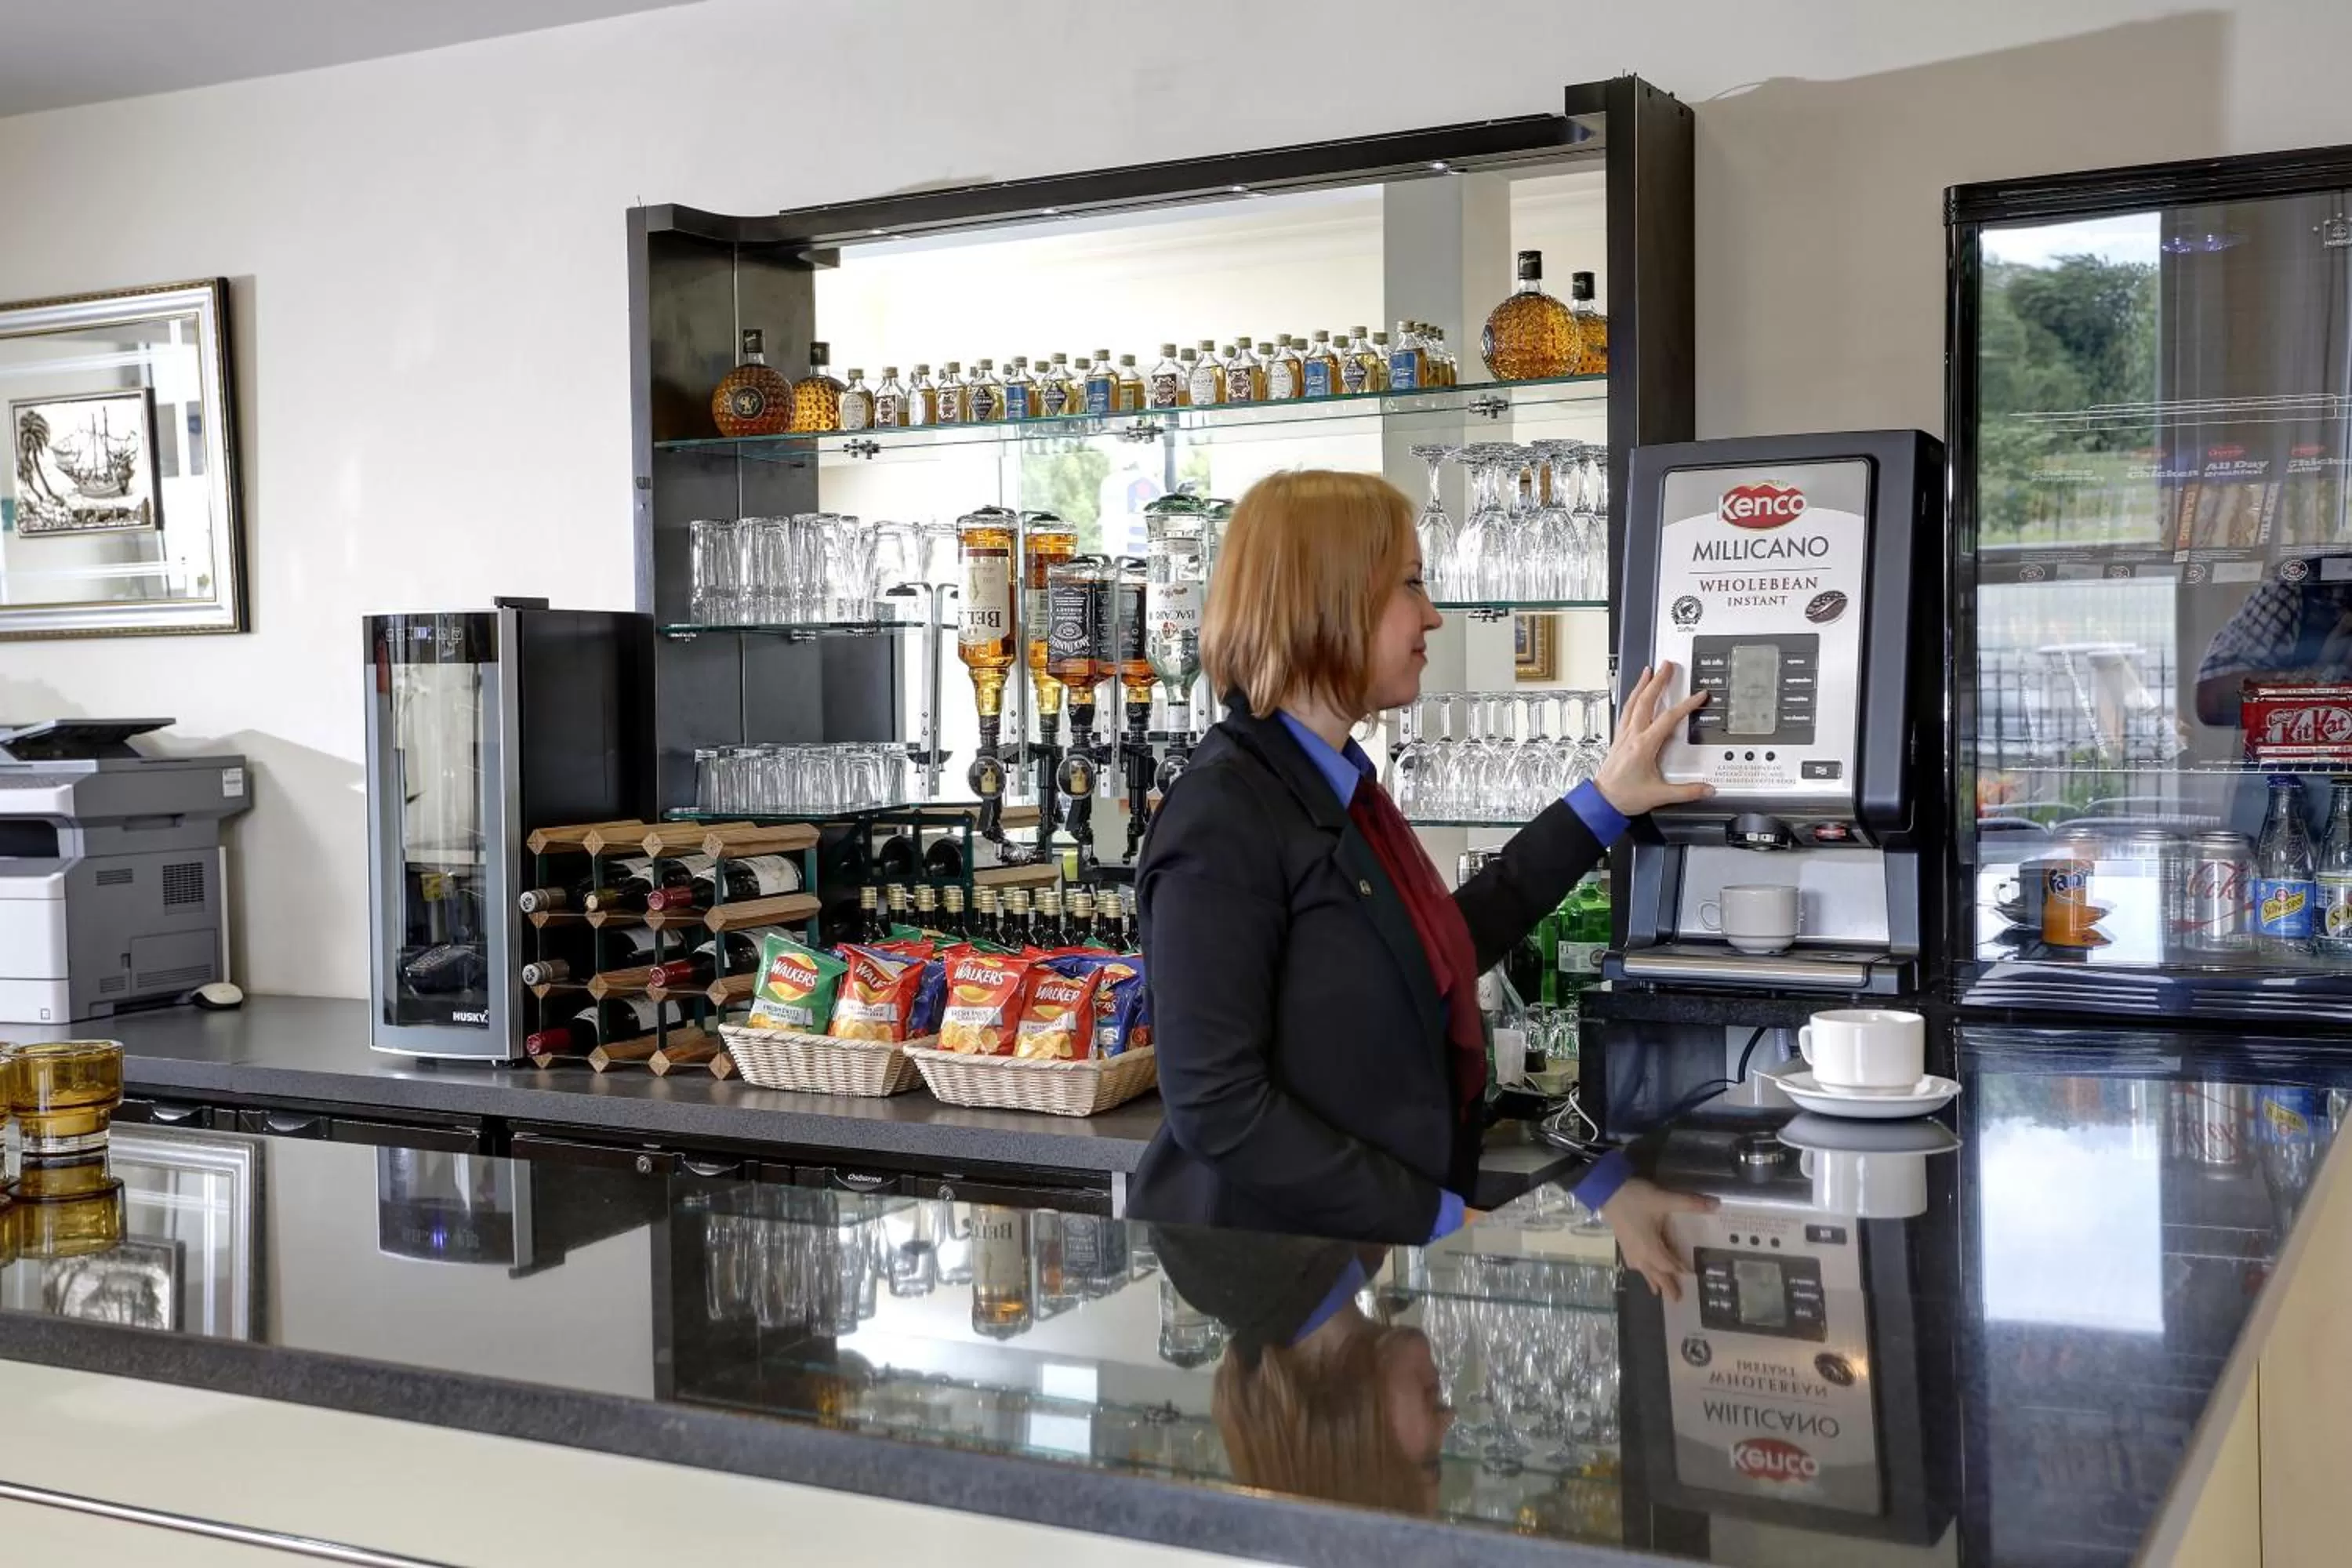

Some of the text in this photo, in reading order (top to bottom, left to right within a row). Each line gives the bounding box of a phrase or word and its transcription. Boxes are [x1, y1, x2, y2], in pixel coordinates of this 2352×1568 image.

[1717, 494, 1807, 521] Kenco
[1693, 536, 1829, 561] MILLICANO
[1700, 576, 1819, 593] WHOLEBEAN
[1727, 595, 1788, 607] INSTANT
[771, 960, 818, 987] WALKERS
[954, 964, 1004, 986] WALKERS
[452, 1010, 487, 1023] HUSKY
